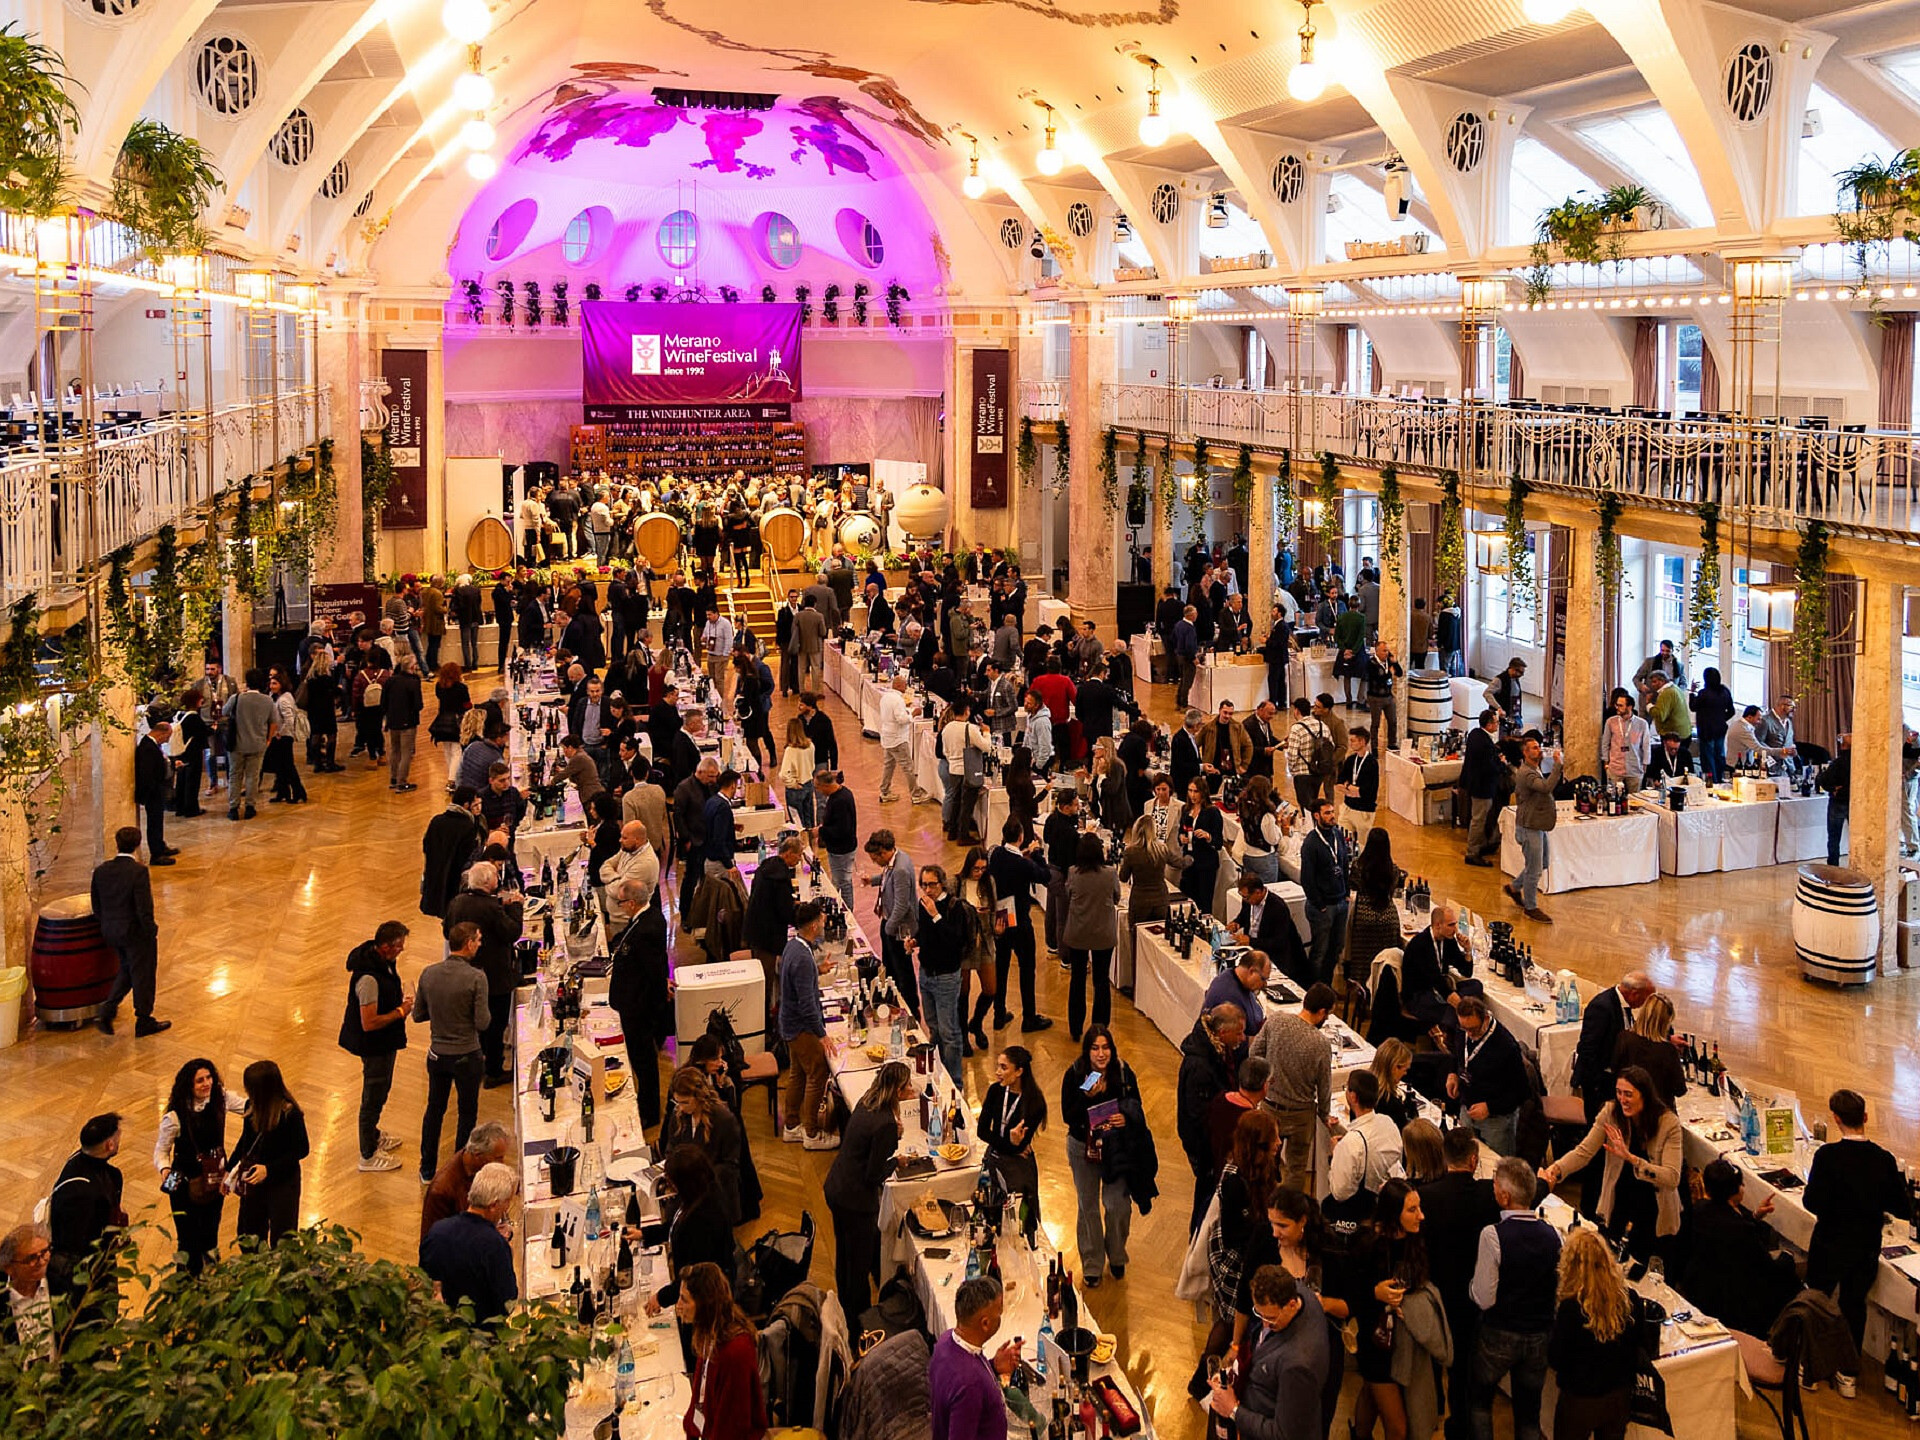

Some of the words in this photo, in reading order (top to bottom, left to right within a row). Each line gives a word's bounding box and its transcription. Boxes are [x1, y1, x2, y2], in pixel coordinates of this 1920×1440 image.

[664, 334, 721, 348] Merano
[664, 348, 758, 363] WineFestival
[664, 367, 684, 375] since
[686, 367, 705, 375] 1992
[400, 377, 411, 445] WineFestival
[626, 409, 649, 419] THE
[651, 409, 722, 419] WINEHUNTER
[723, 408, 751, 418] AREA
[977, 396, 987, 434] Merano
[986, 374, 996, 434] WineFestival
[389, 404, 400, 445] Merano
